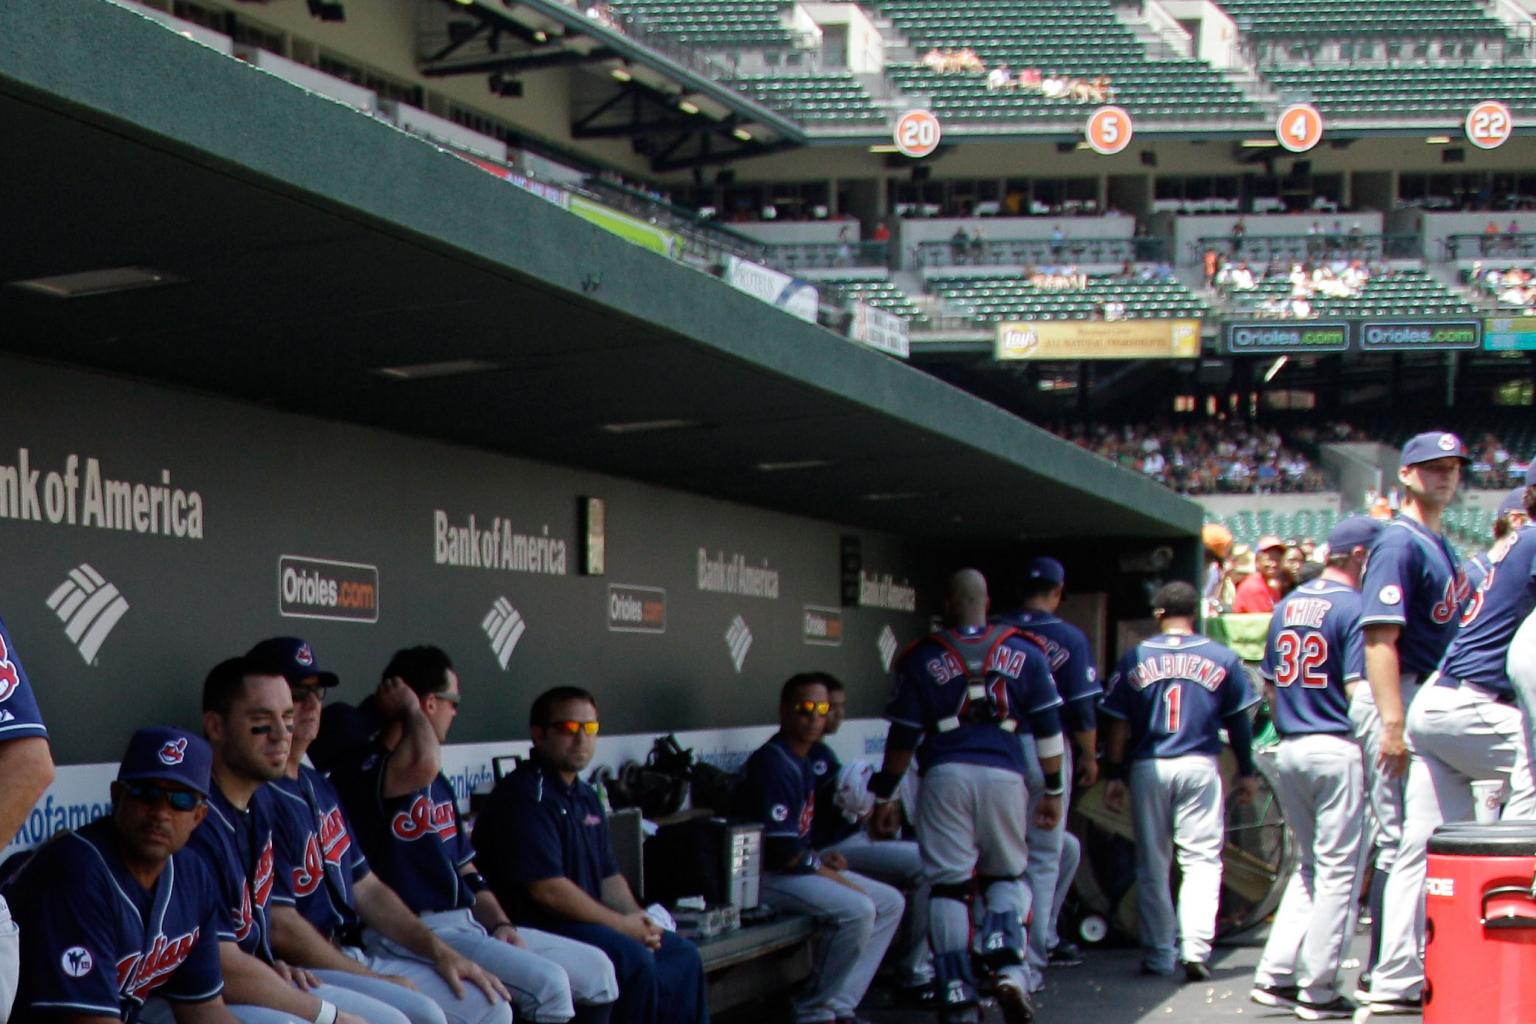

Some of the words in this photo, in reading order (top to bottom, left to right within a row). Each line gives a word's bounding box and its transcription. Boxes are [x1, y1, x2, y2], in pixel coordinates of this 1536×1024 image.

[904, 121, 935, 146] 20
[1100, 116, 1119, 142] 5
[1290, 114, 1308, 139] 4
[1472, 111, 1506, 136] 22
[1236, 328, 1343, 346] Orioles.com
[1367, 326, 1473, 344] Orioles.com
[44, 454, 79, 525] of
[82, 457, 204, 540] America
[434, 509, 481, 566] Bank
[481, 516, 501, 569] of
[501, 518, 566, 576] America
[283, 566, 375, 610] Orioles.com
[1283, 597, 1333, 629] WHITE
[1275, 629, 1328, 689] 32
[1163, 683, 1182, 734] 1
